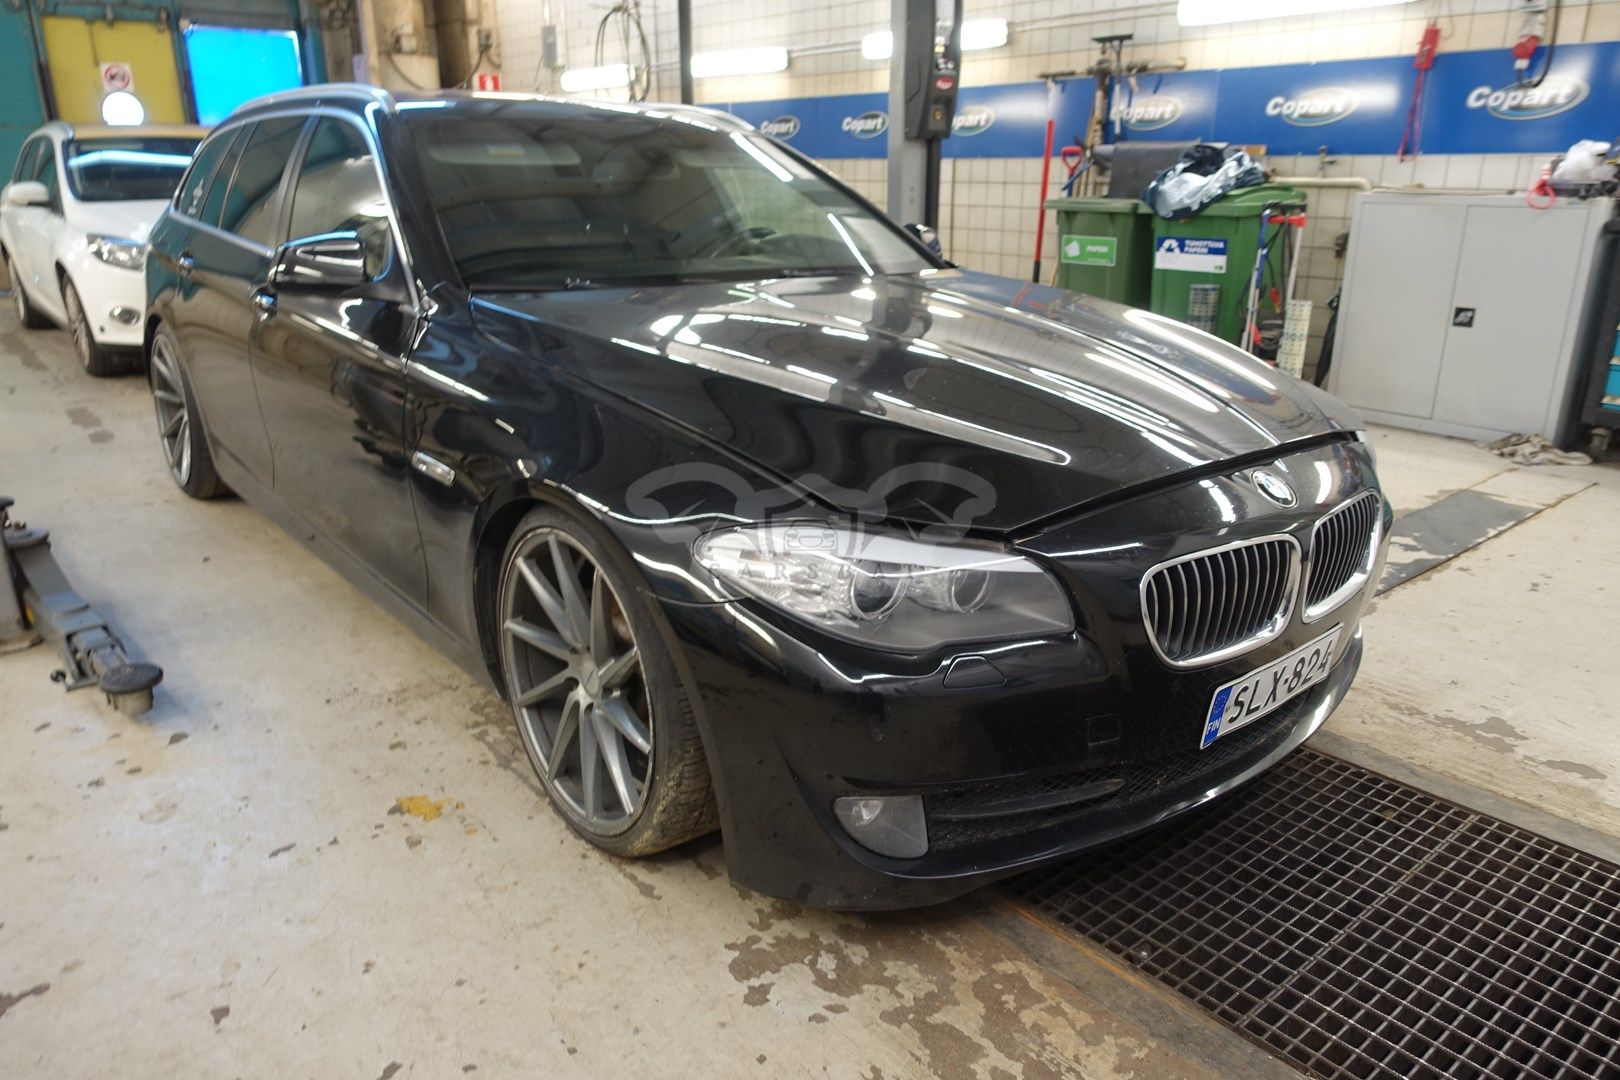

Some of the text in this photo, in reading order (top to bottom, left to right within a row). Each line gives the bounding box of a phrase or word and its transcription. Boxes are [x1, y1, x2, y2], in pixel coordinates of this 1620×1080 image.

[1265, 95, 1348, 119] Copart
[1466, 84, 1571, 110] Copart
[842, 116, 884, 133] Copart
[1228, 639, 1333, 724] SLX-824
[1207, 717, 1221, 734] FIN
